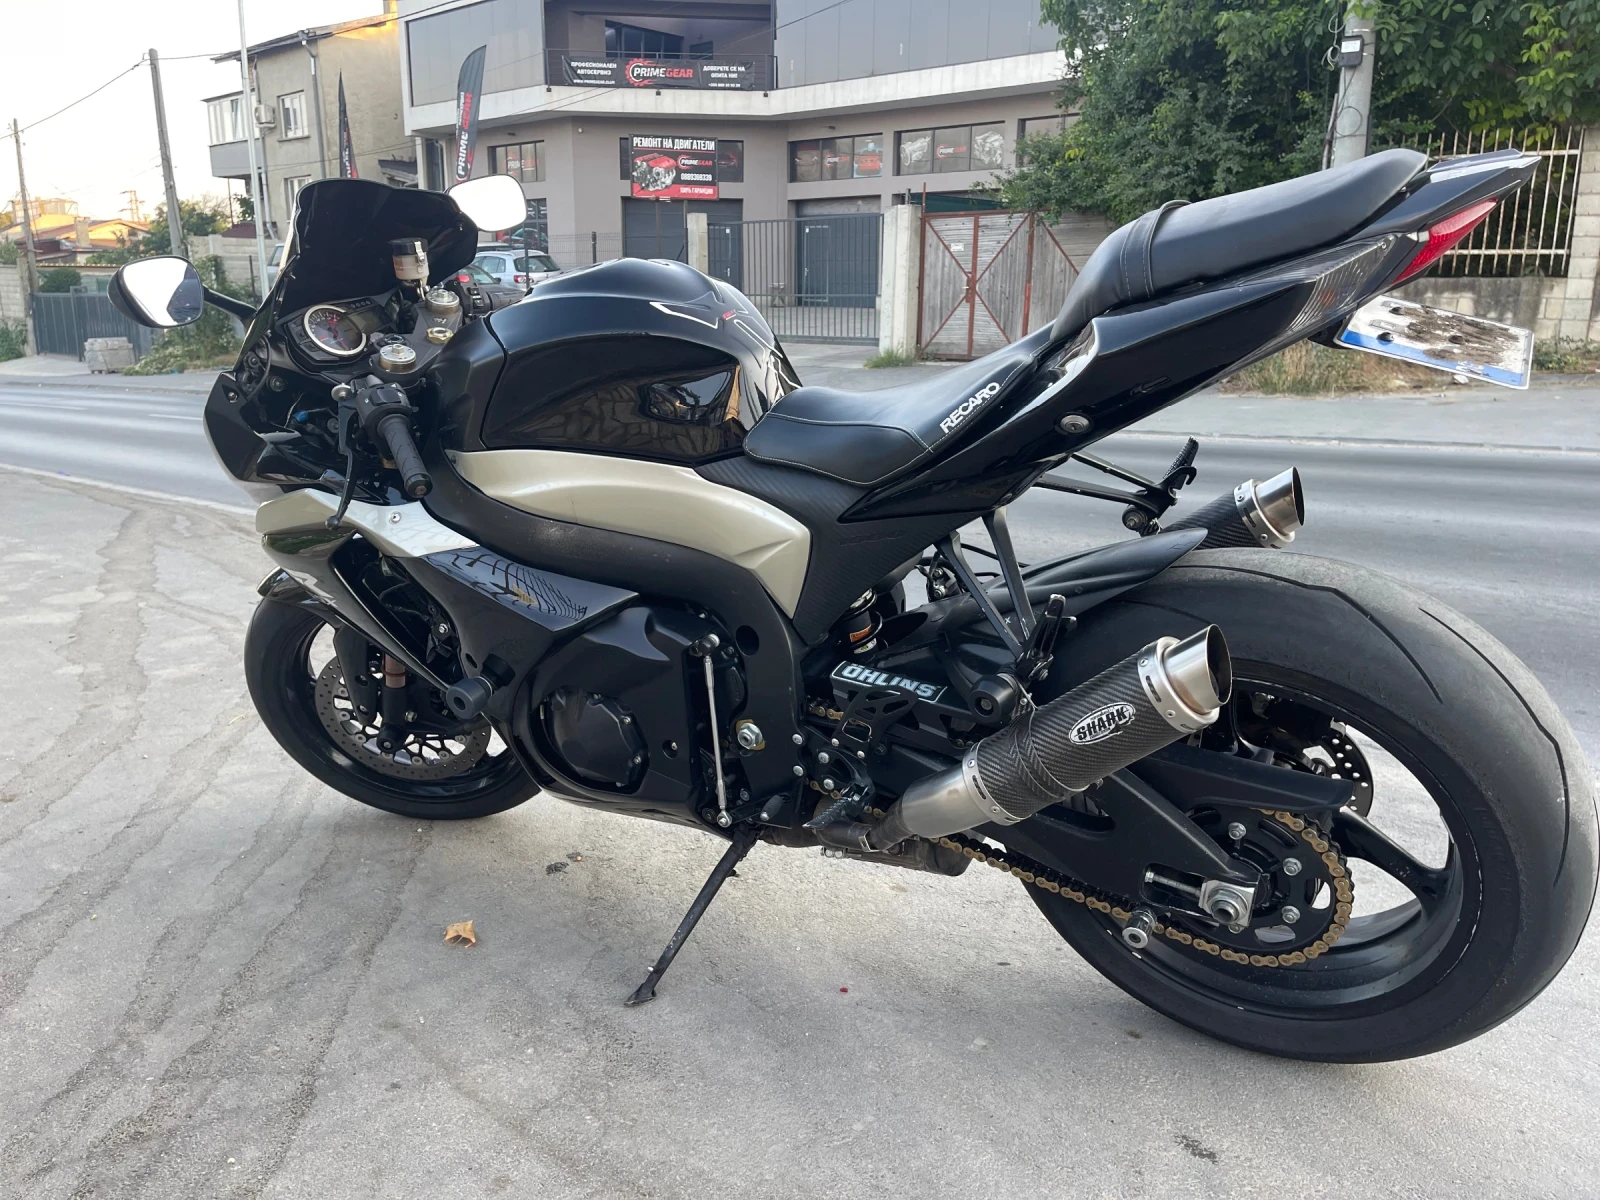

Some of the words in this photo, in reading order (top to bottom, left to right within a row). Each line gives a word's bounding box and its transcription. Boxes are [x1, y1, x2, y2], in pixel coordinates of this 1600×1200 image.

[633, 137, 661, 147] РЕМОНТ
[662, 138, 673, 148] НА
[674, 139, 715, 150] ДВИГАТЕЛИ
[940, 382, 1000, 433] RECARO
[842, 663, 938, 697] ÖHLINS
[1076, 706, 1128, 740] SHARK
